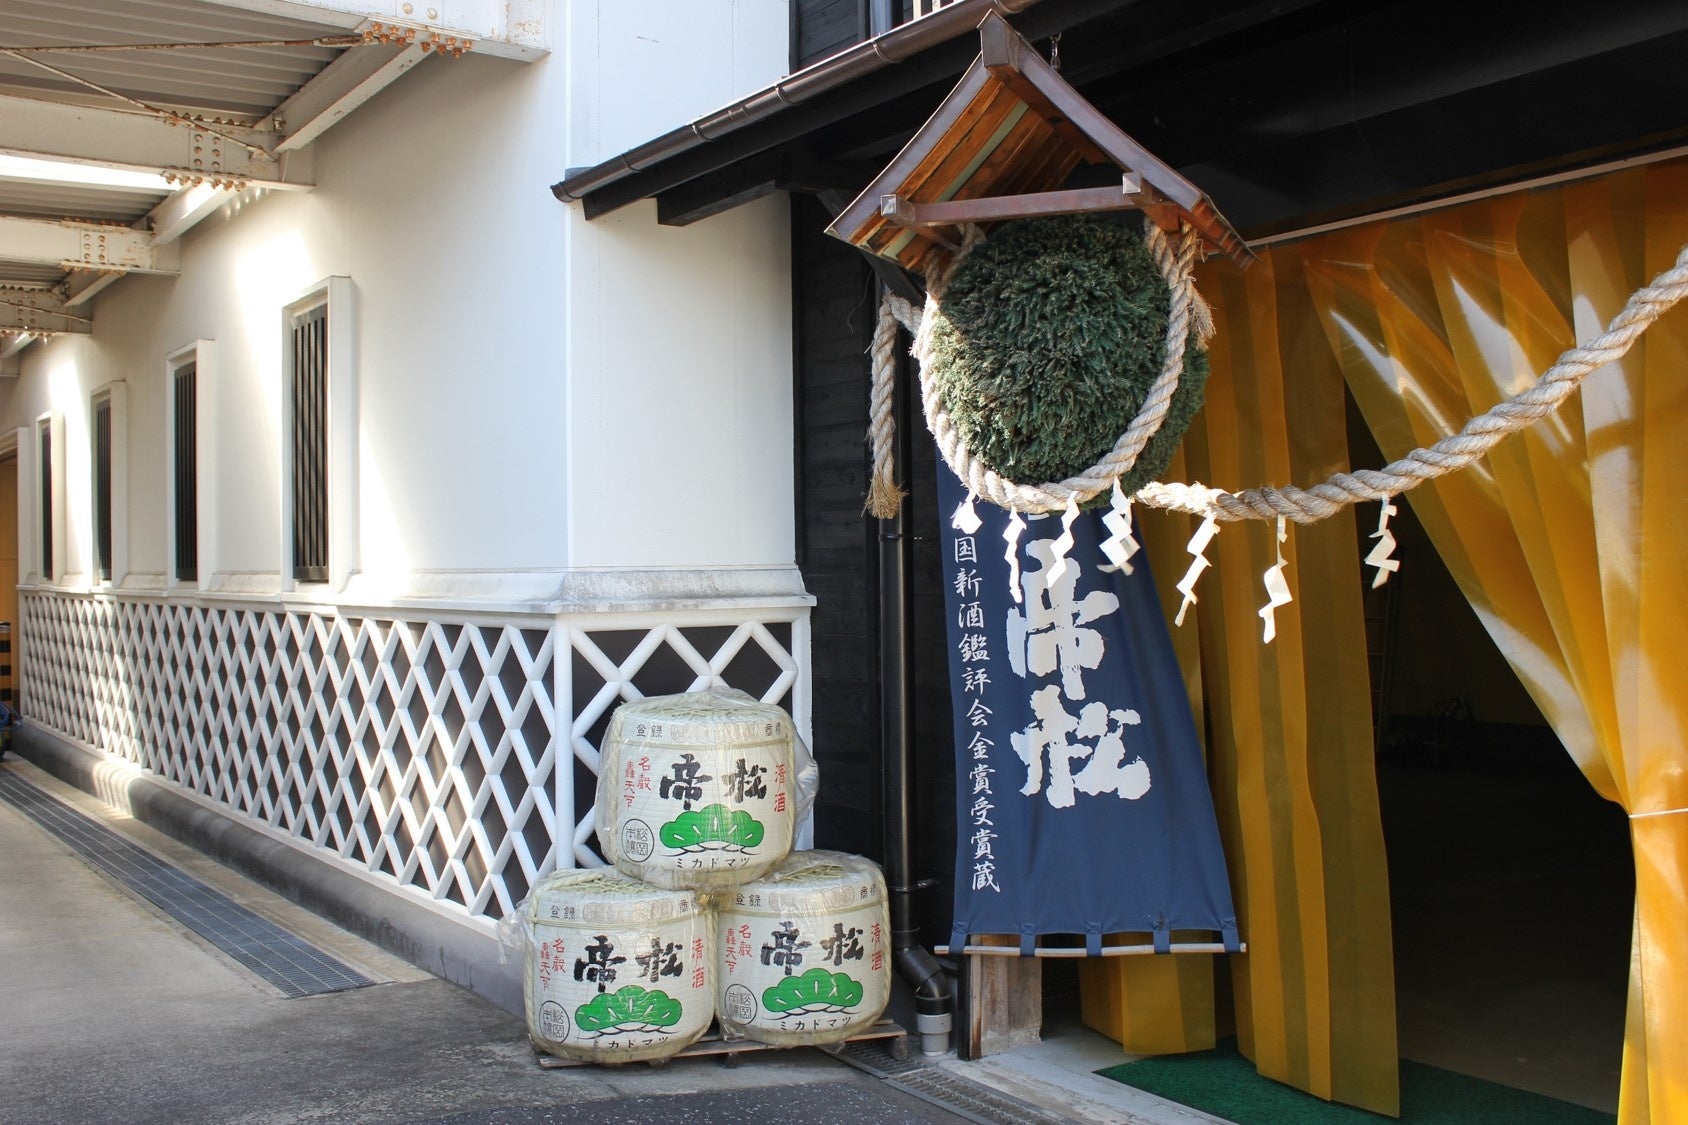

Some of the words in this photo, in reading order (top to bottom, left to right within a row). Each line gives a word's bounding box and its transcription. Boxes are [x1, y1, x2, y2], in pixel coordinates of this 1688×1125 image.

[950, 502, 1001, 893] 国新酒鑑評会金賞受賞蔵
[1006, 538, 1151, 809] 帝松
[676, 857, 750, 869] ミカドマツ
[780, 1016, 852, 1032] ミカドマツ
